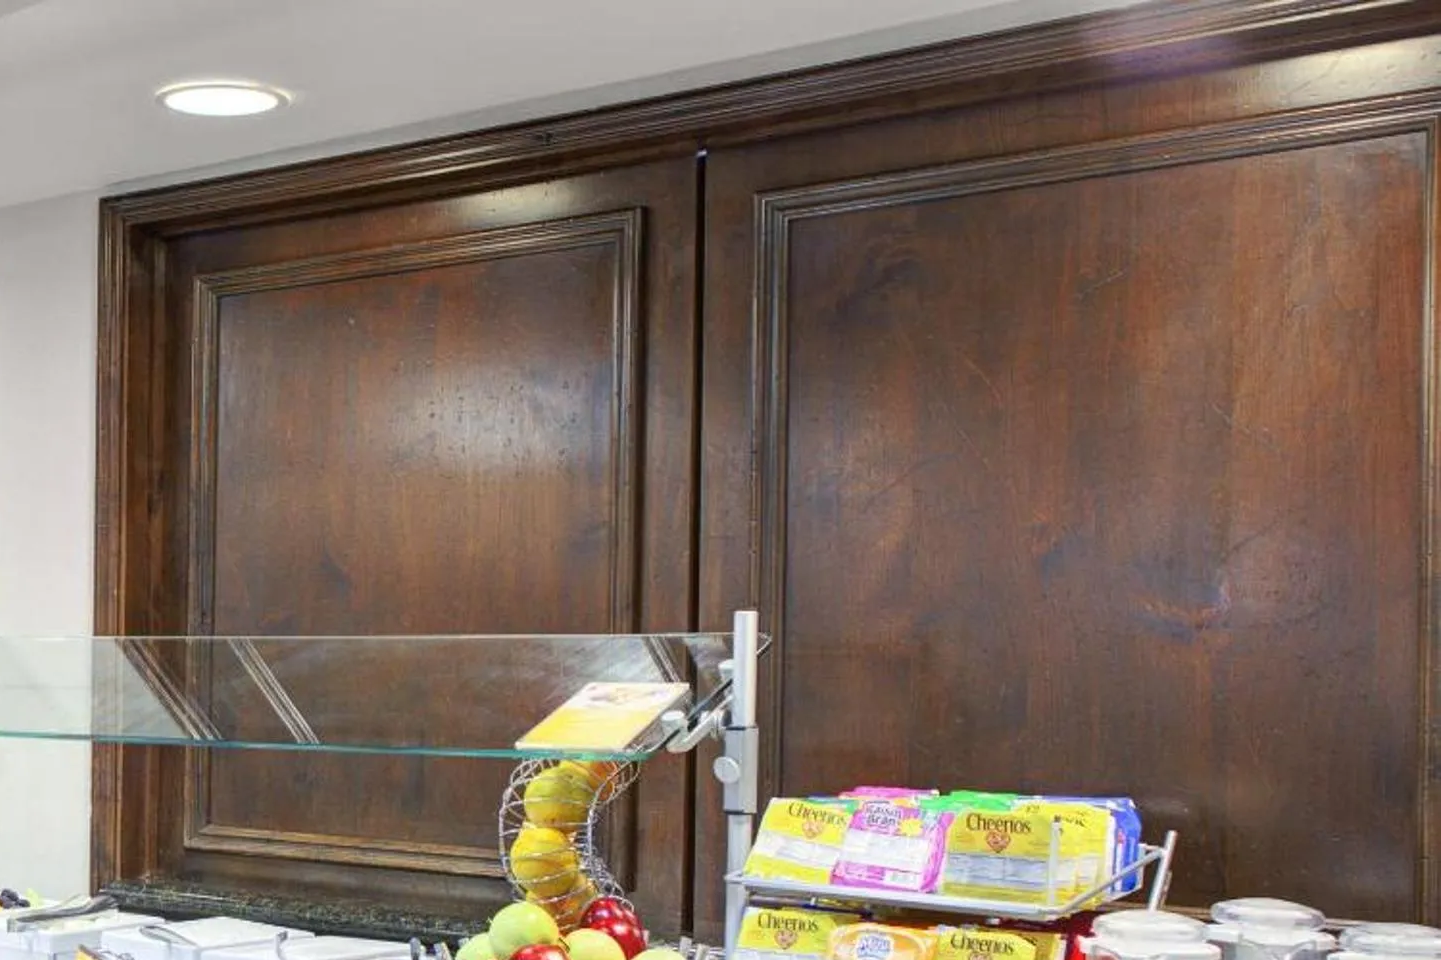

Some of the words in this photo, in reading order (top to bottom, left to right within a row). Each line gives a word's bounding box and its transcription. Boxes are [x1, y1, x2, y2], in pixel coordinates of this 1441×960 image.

[788, 801, 846, 825] Cheerios
[966, 812, 1032, 834] Cheerios
[758, 911, 819, 933] Cheerios
[950, 933, 1015, 955] Cheerios
